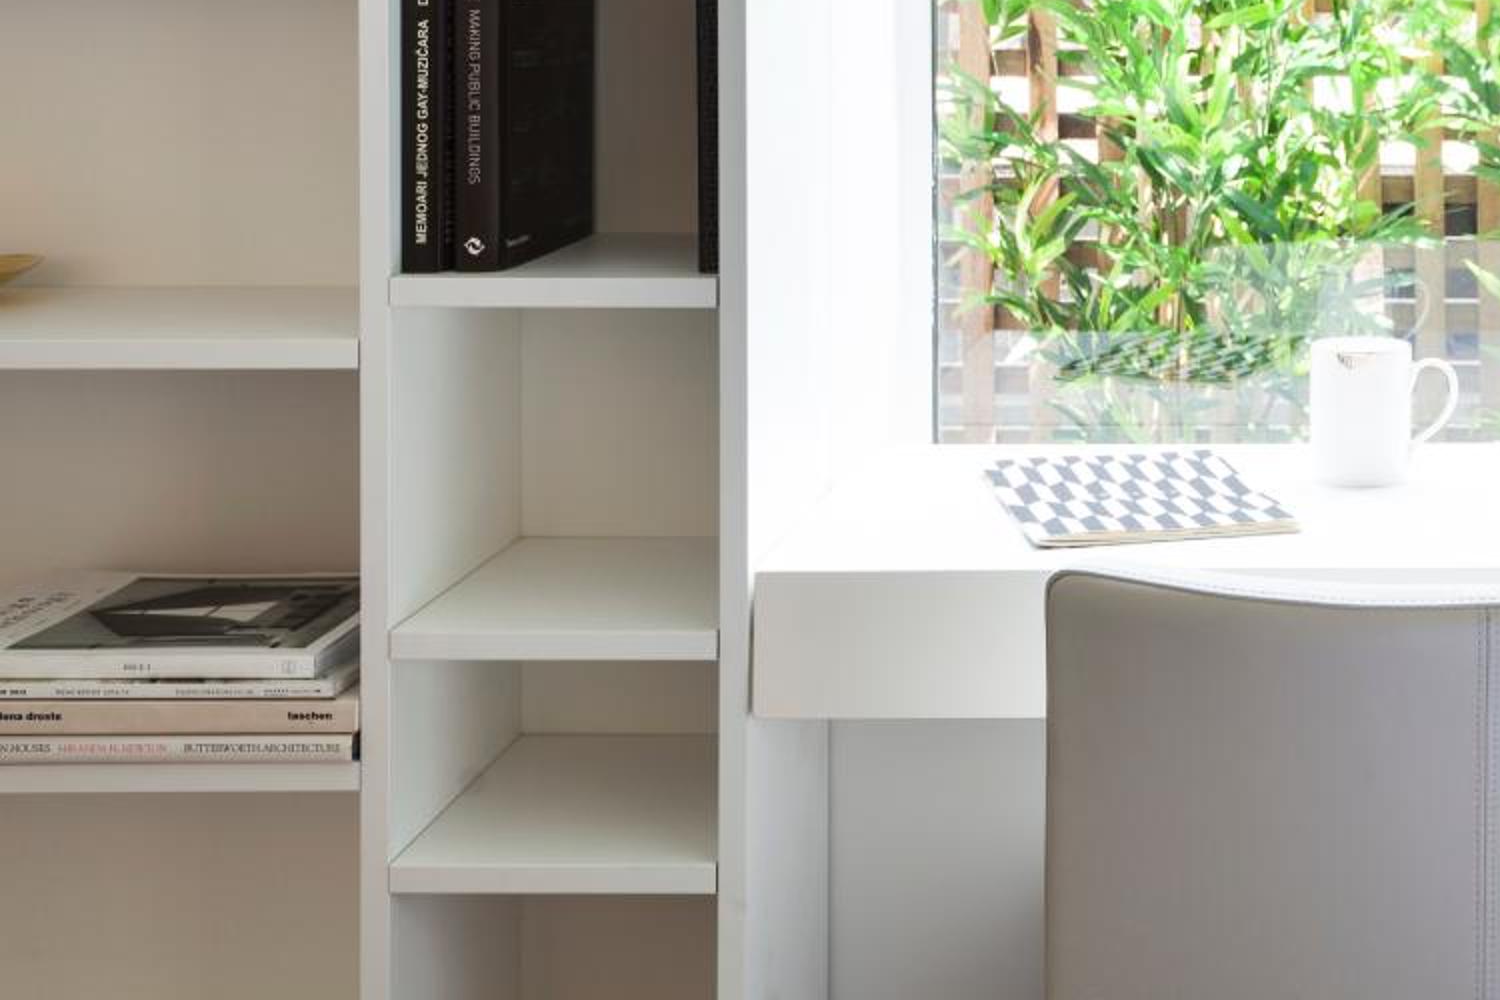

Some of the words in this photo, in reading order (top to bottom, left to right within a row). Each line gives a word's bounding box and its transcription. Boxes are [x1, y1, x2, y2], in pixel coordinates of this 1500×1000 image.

[468, 9, 481, 60] MAKING
[467, 62, 481, 112] PUBLIC
[416, 122, 429, 178] JEDNOG
[467, 114, 481, 185] BUILDINGS
[415, 181, 428, 245] MEMOARI
[25, 711, 63, 721] droste
[287, 711, 333, 721] taschen
